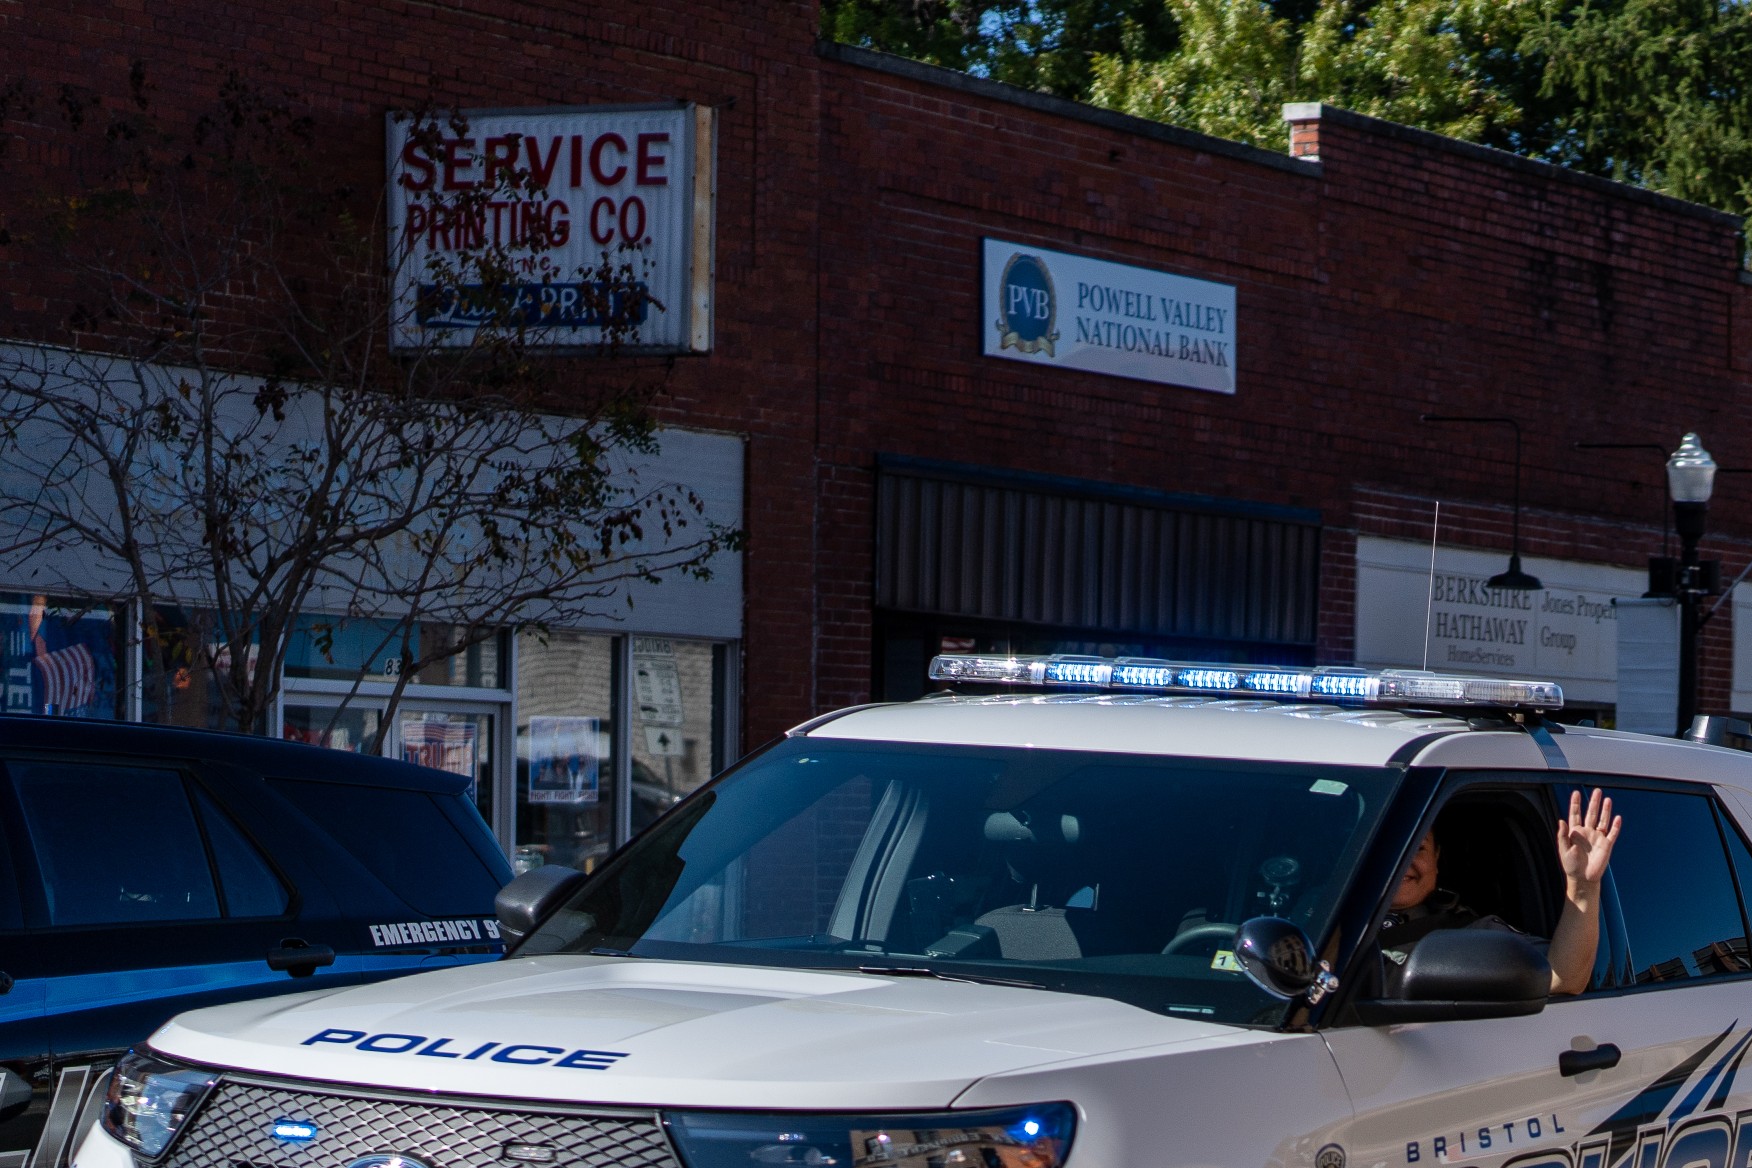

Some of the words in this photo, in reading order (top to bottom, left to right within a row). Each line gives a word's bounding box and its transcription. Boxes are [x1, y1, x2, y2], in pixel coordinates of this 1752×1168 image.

[403, 132, 669, 191] SERVICE
[590, 195, 652, 245] CO.
[1007, 284, 1049, 320] PVB
[1077, 281, 1157, 322] POWELL
[1160, 297, 1228, 334] VALLEY
[1075, 316, 1176, 359] NATIONAL
[1177, 337, 1229, 368] BANK
[1433, 575, 1532, 611] BERKSHIRE
[1435, 612, 1528, 645] HATHAWAY
[1540, 625, 1578, 655] Group
[368, 920, 481, 947] EMERGENCY
[301, 1028, 632, 1070] POLICE
[1406, 1112, 1565, 1163] BRISTOL
